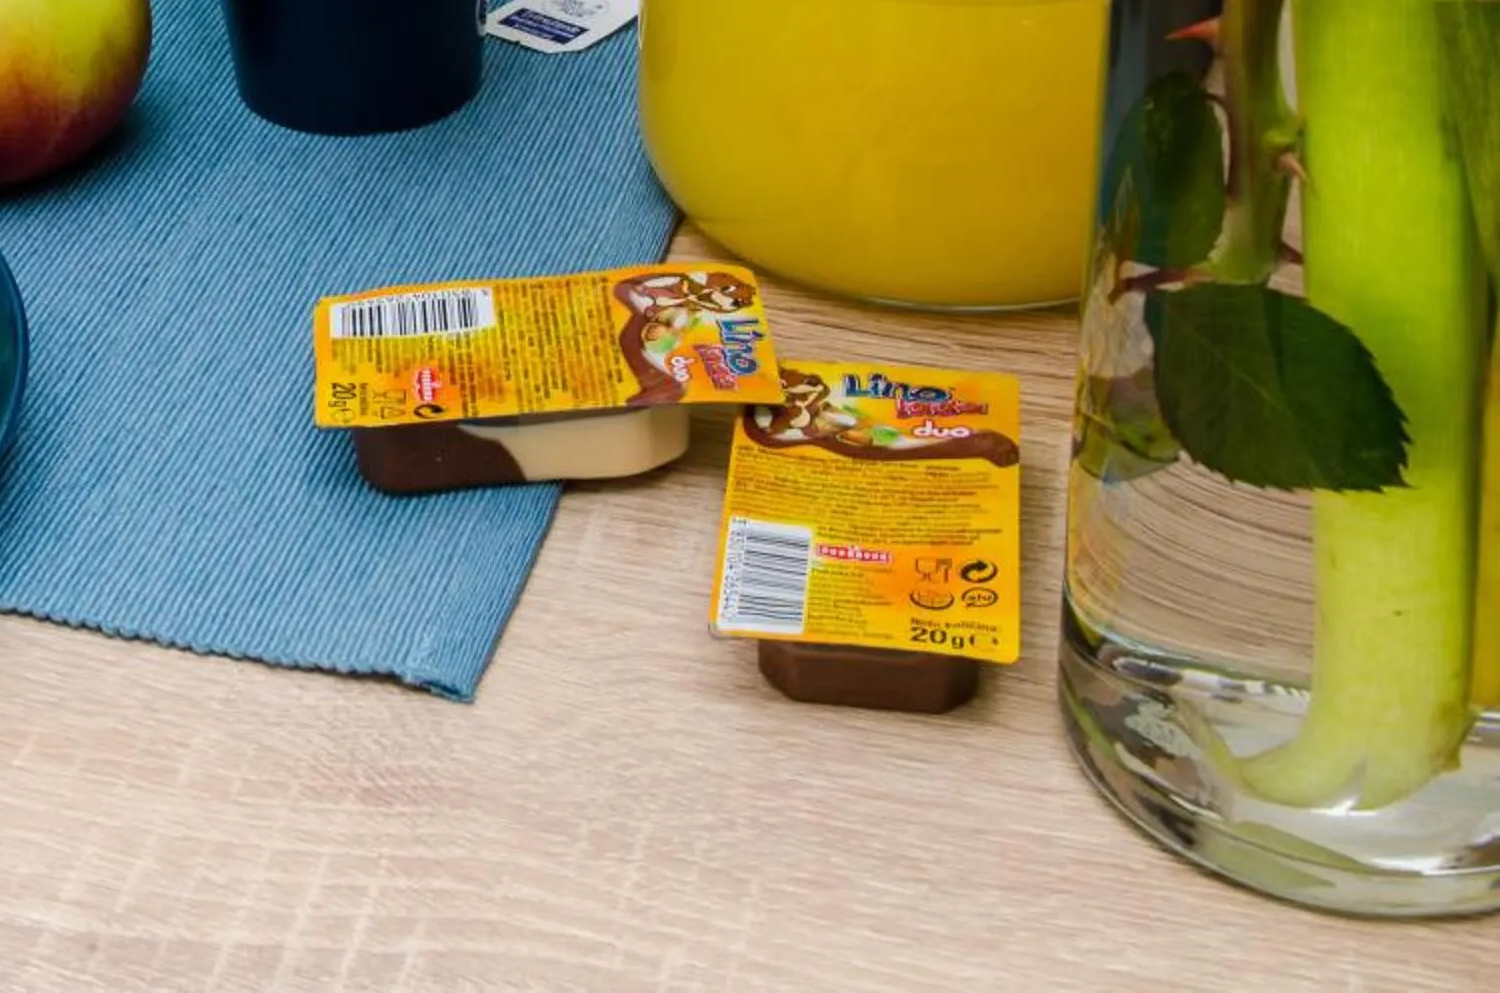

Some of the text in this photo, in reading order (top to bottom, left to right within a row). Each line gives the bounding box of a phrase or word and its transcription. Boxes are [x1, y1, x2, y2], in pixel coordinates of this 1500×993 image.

[717, 318, 765, 375] Lino
[671, 356, 696, 383] duo
[842, 373, 951, 402] Lino
[913, 419, 970, 438] duo
